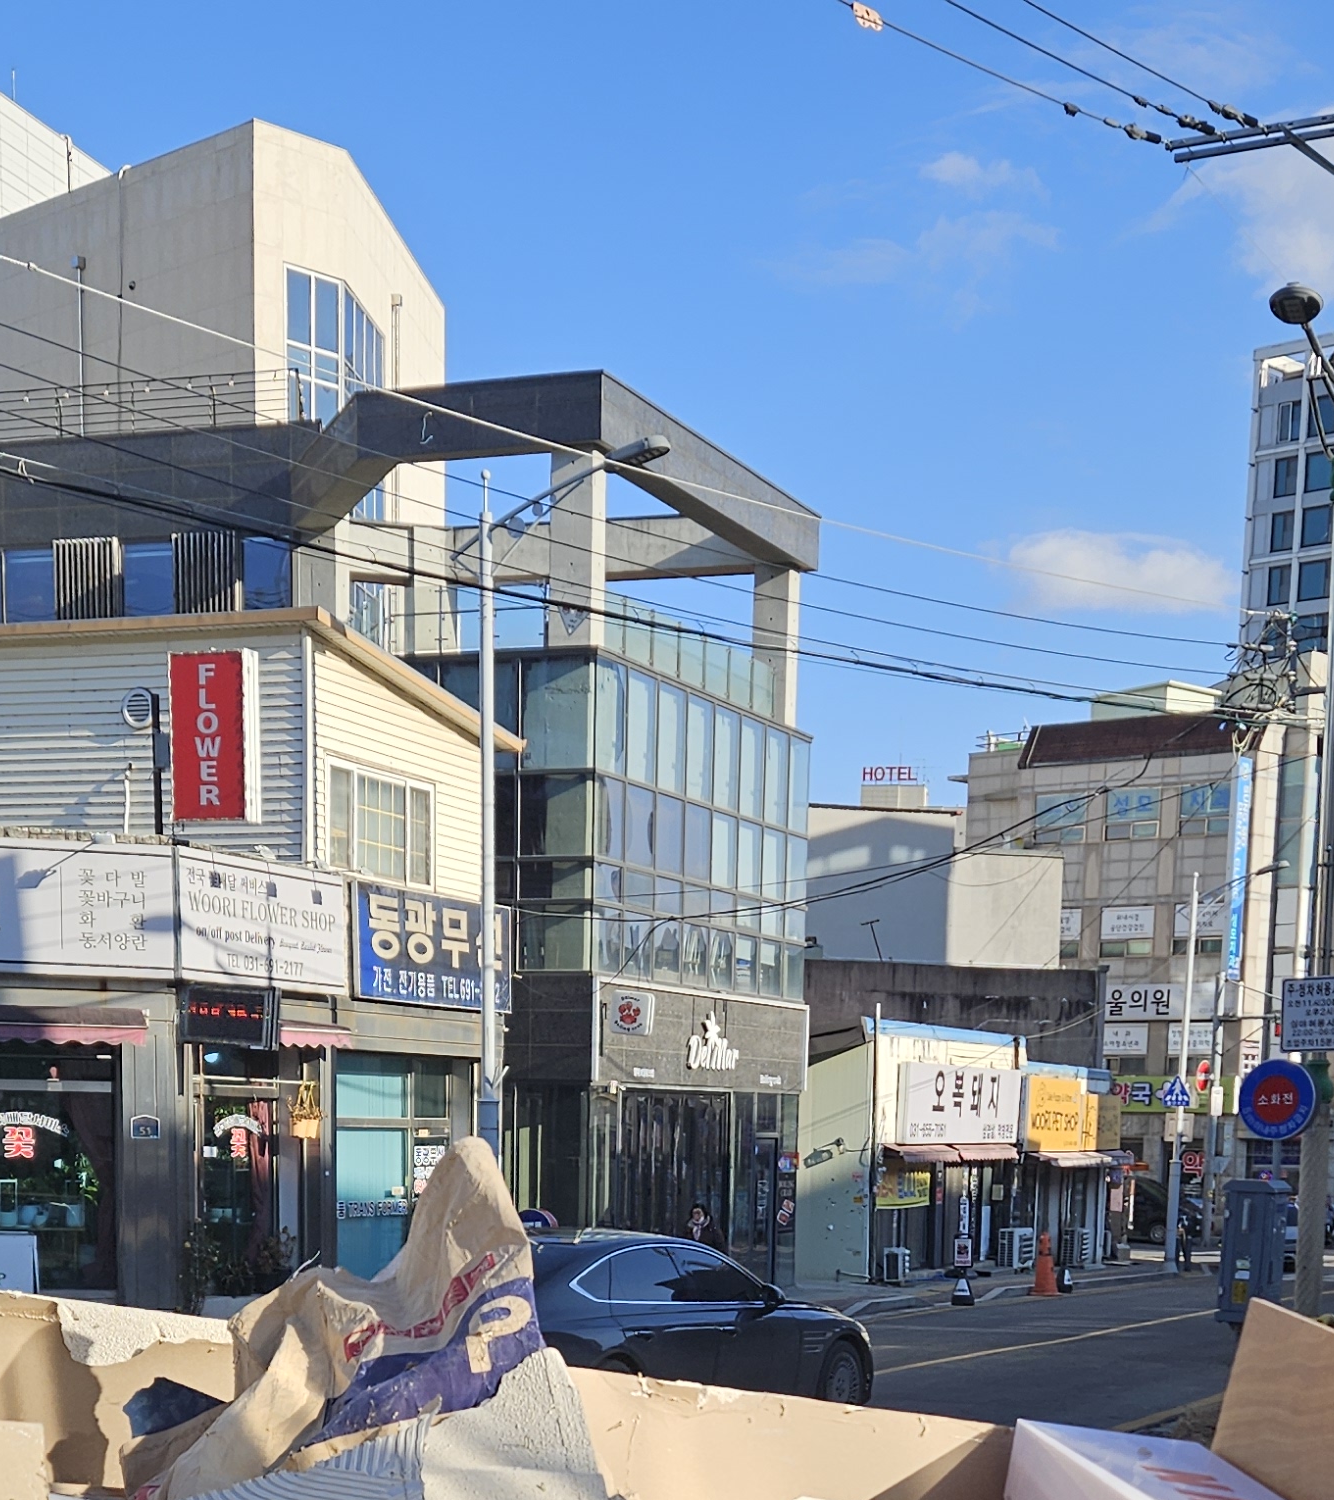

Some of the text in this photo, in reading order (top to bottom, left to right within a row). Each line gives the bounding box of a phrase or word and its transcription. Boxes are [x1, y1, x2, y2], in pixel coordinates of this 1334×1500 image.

[194, 663, 222, 806] FLOWER
[862, 766, 918, 782] HOTEL
[78, 890, 147, 910] 꽃바구니
[188, 889, 336, 933] WOORI FLOWER SHOP
[224, 929, 243, 944] post
[226, 953, 304, 977] TEL 031-691-2177
[398, 969, 435, 998] 전기용품
[932, 1070, 1001, 1118] 오복돼지
[1257, 1092, 1293, 1105] 소화전
[2, 1126, 35, 1159] 꽃
[139, 1126, 152, 1136] 51
[230, 1127, 247, 1158] 꽃
